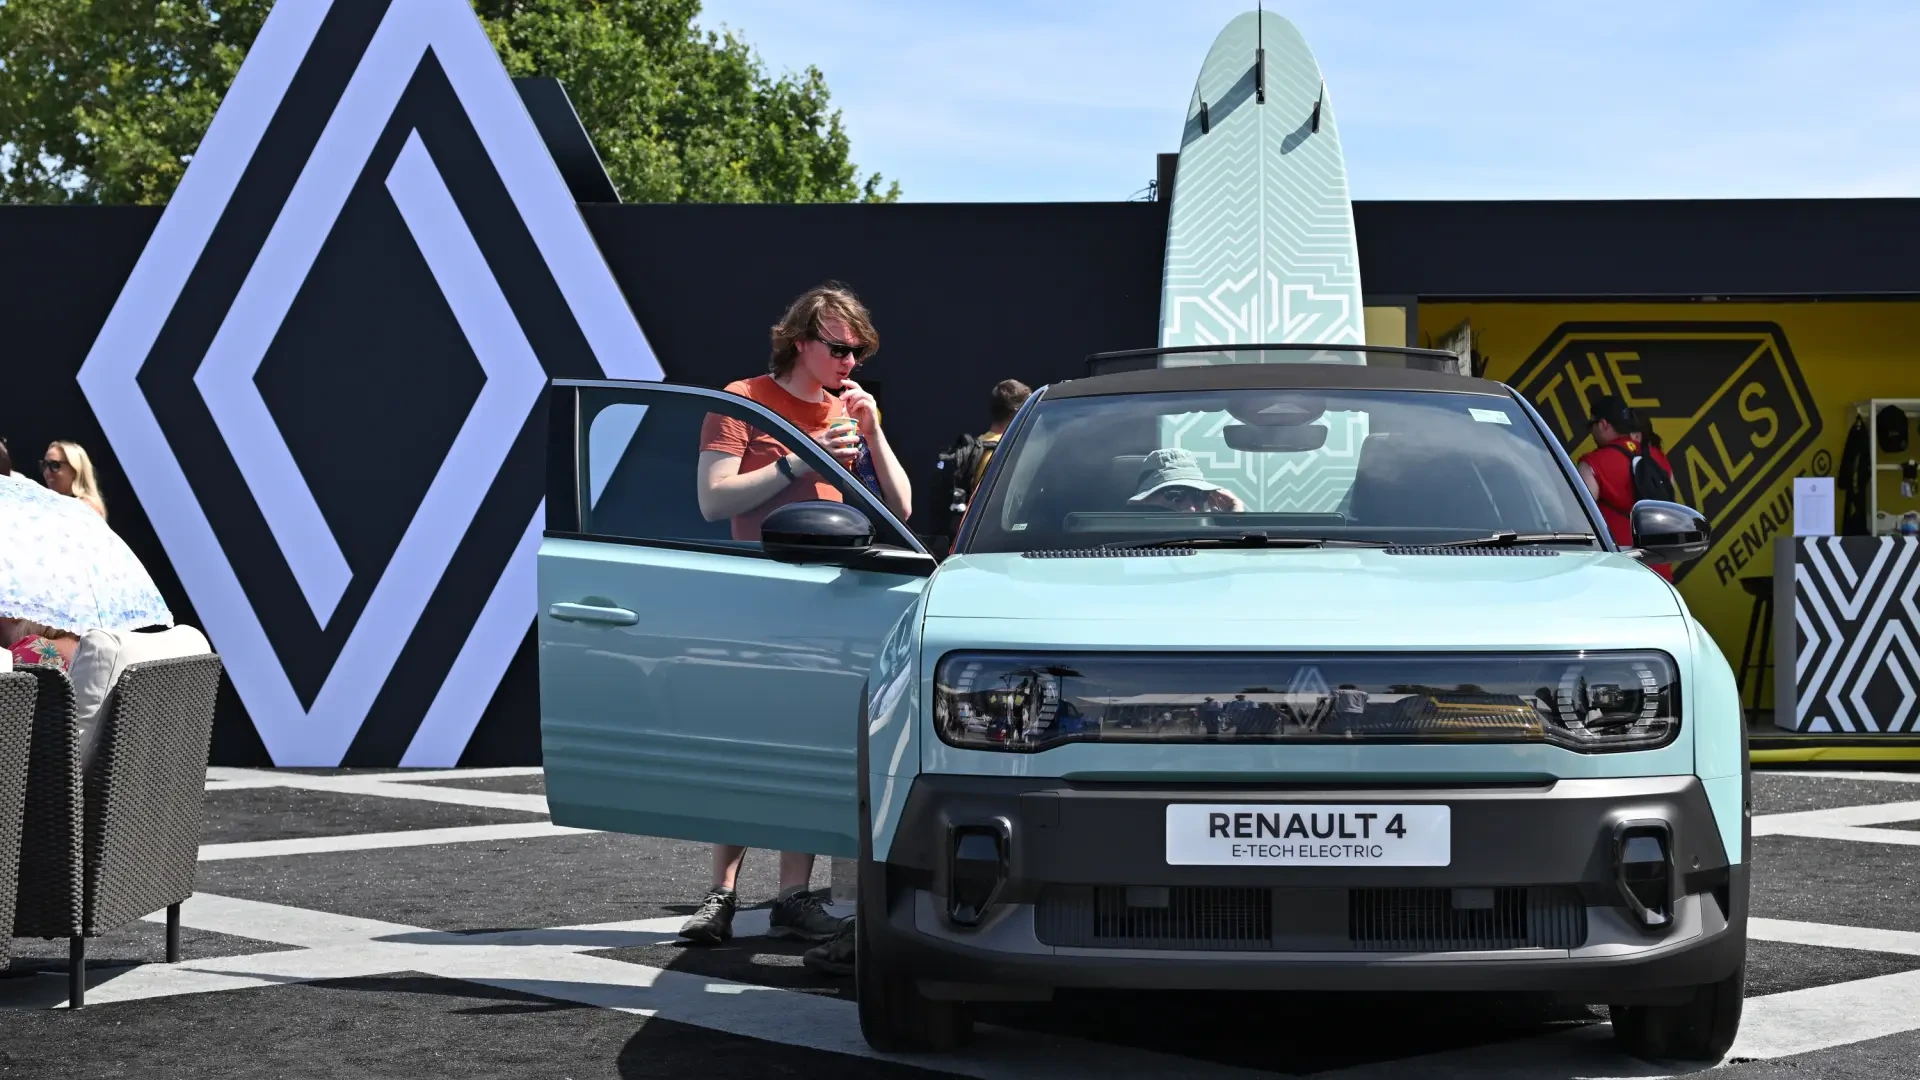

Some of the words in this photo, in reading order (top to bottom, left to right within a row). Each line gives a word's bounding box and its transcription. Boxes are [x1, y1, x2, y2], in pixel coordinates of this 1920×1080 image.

[1535, 351, 1661, 442] THE
[1209, 812, 1378, 839] RENAULT
[1385, 813, 1407, 839] 4
[1232, 844, 1294, 858] E-TECH
[1299, 844, 1383, 858] ELECTRIC
